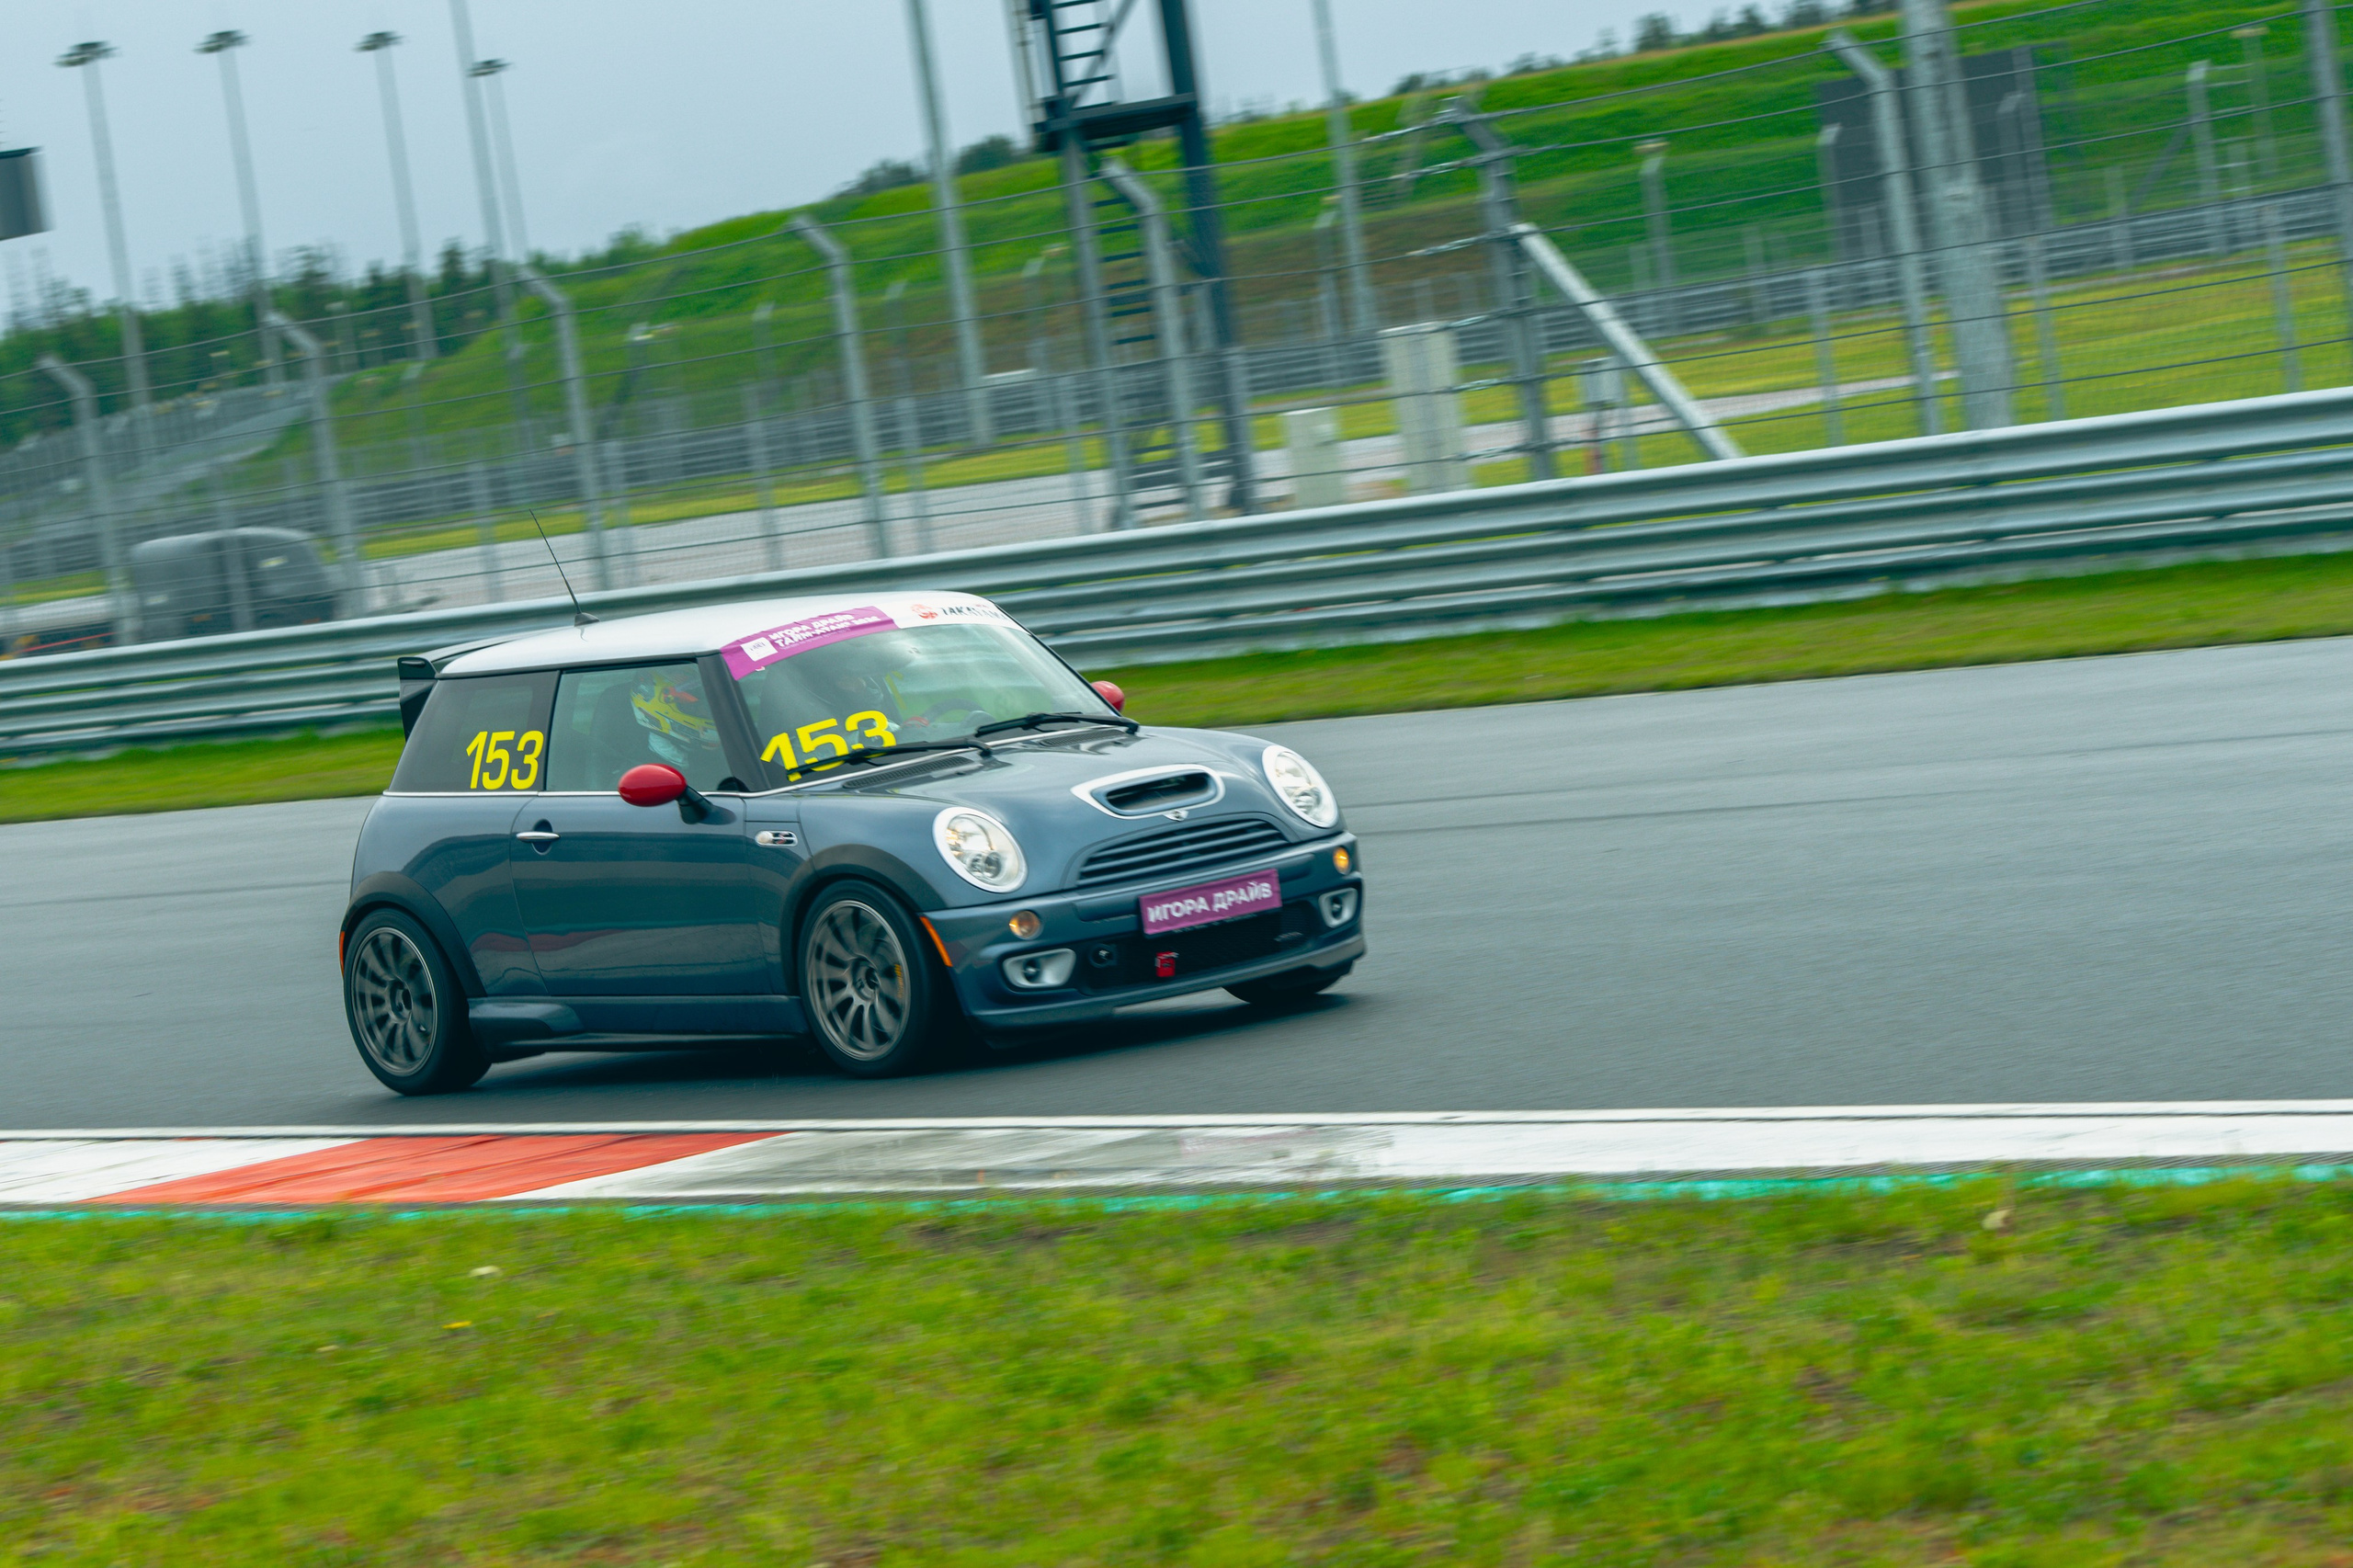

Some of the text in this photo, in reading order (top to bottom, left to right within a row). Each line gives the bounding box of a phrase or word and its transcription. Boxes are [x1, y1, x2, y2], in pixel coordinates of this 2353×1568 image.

[768, 623, 812, 641] ИГОРА
[812, 614, 855, 629] ДРАЙВ
[466, 730, 544, 790] 153
[760, 710, 896, 782] 153
[1147, 881, 1273, 923] ИГОРА ДРАЙВ
